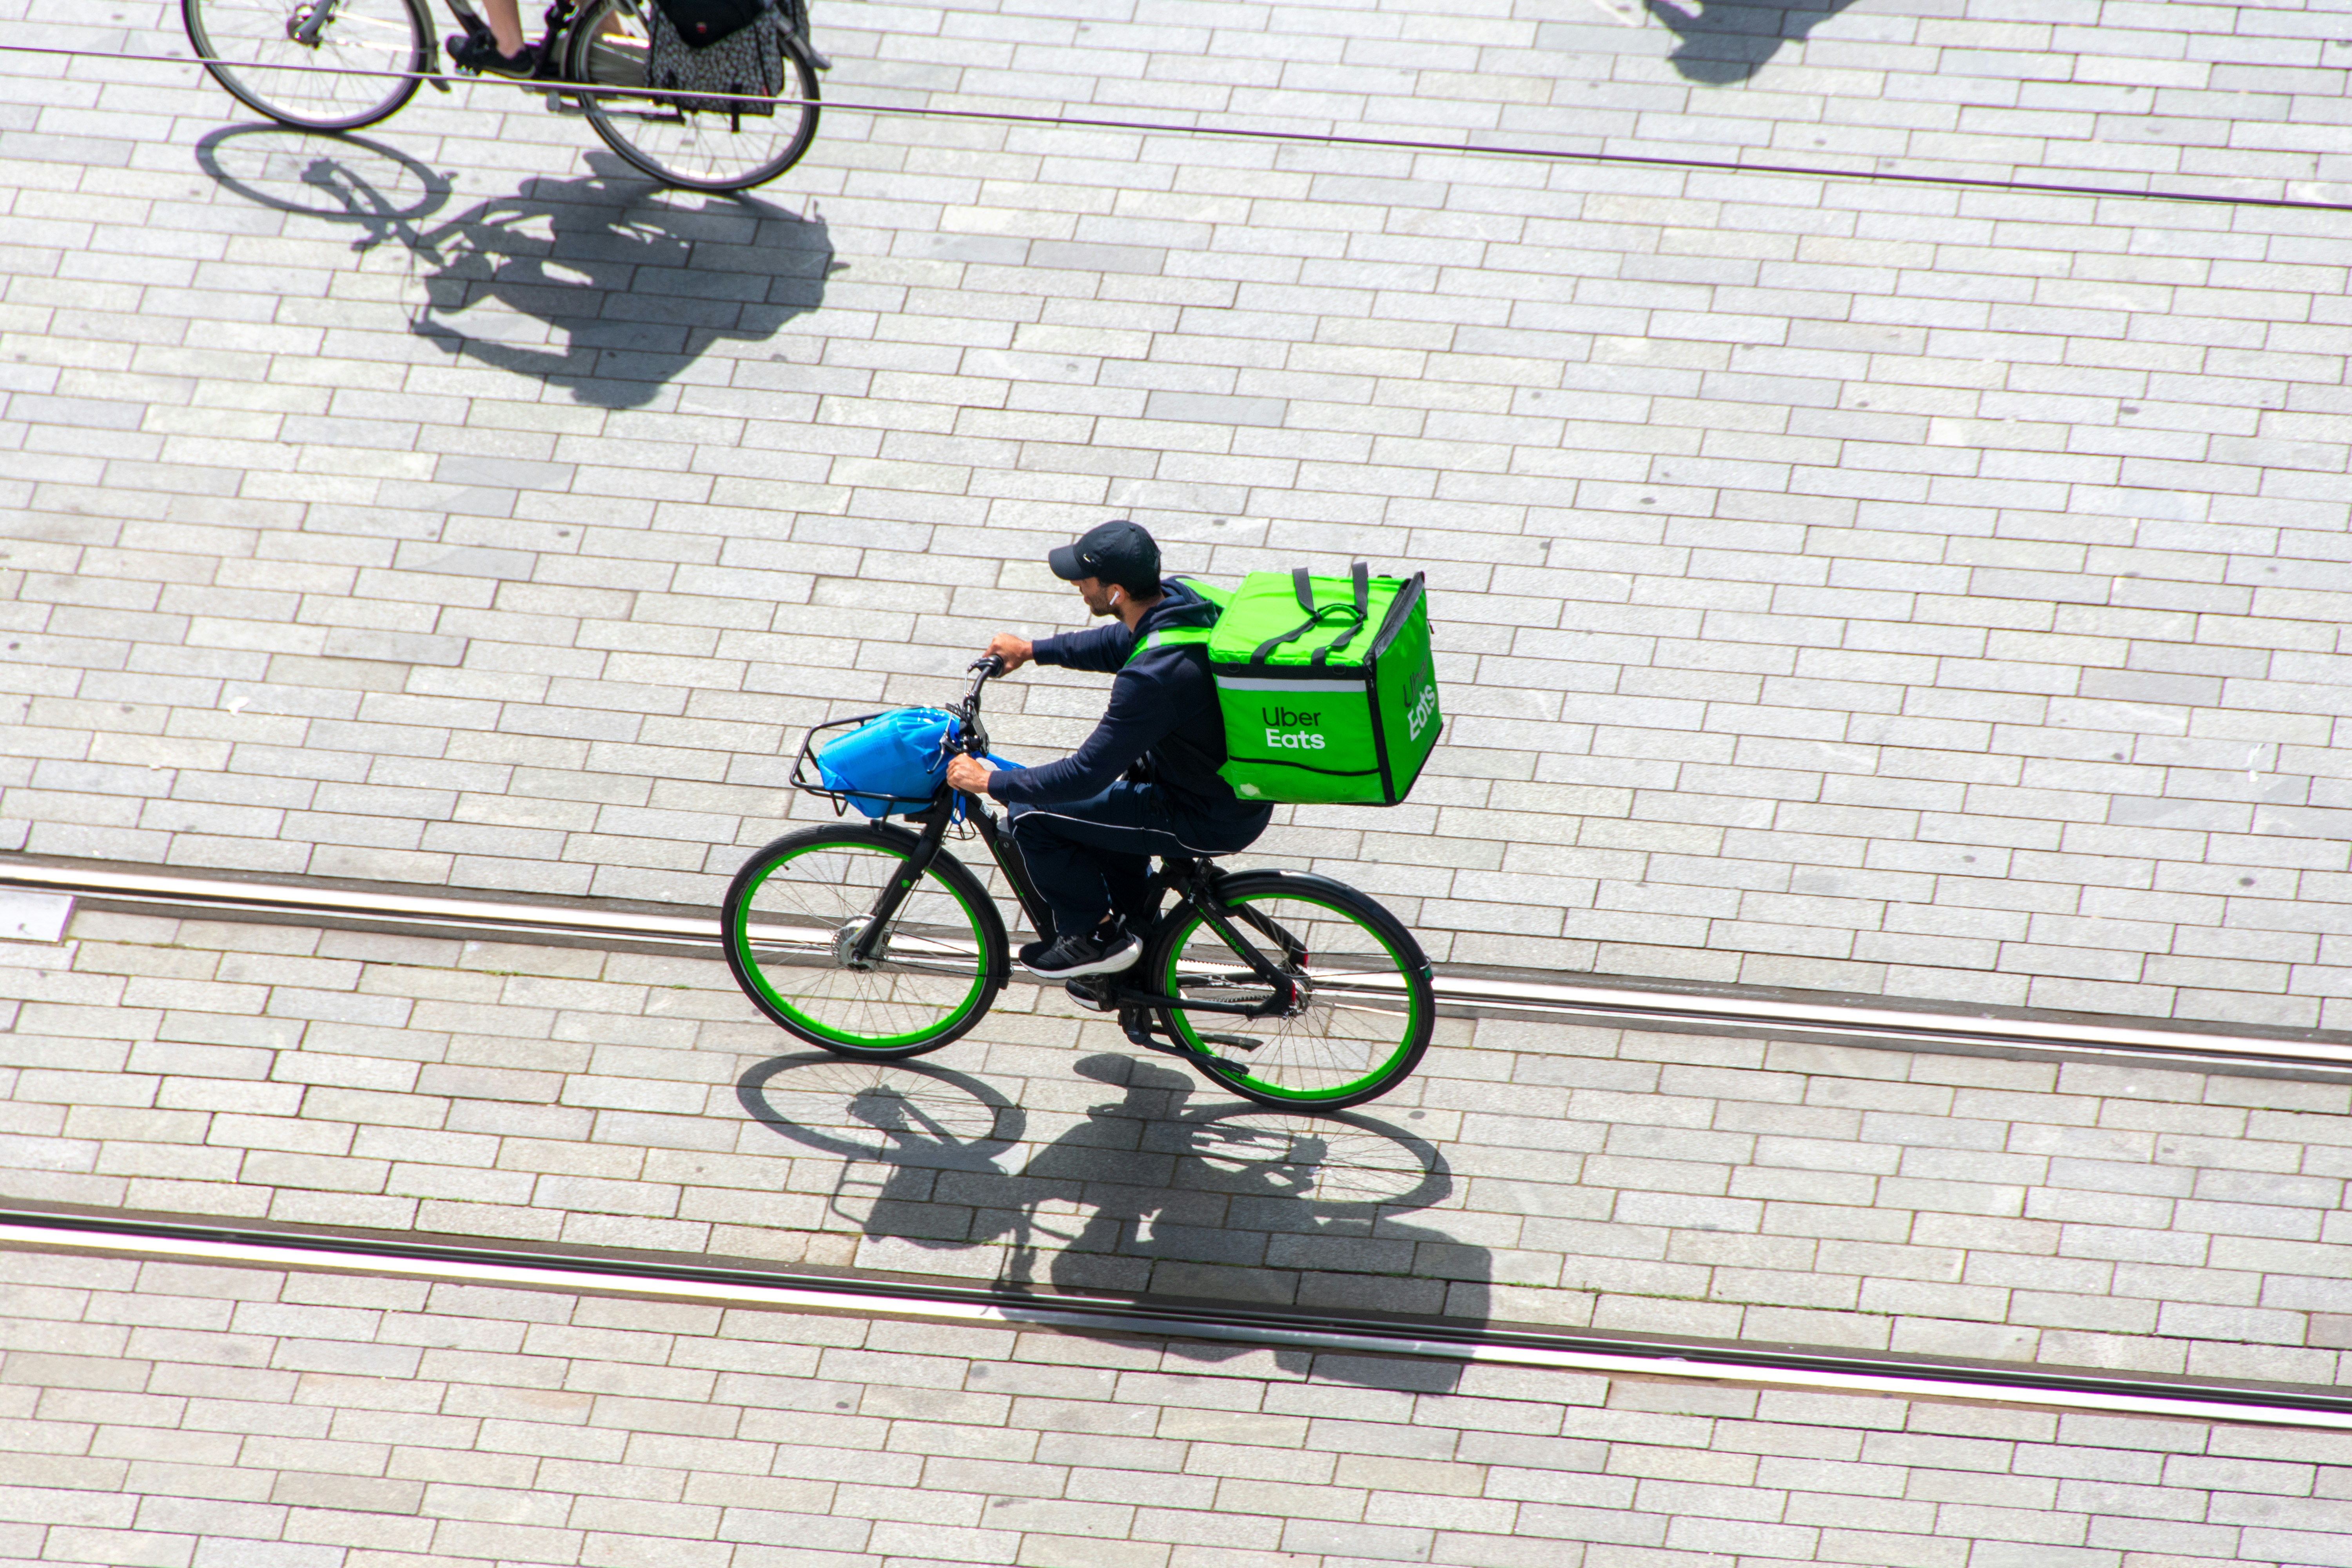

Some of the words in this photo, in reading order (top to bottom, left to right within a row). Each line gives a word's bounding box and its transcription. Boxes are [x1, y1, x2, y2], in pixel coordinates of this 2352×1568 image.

[1262, 707, 1321, 726] Uber
[1407, 685, 1435, 742] Eats
[1265, 728, 1325, 749] Eats
